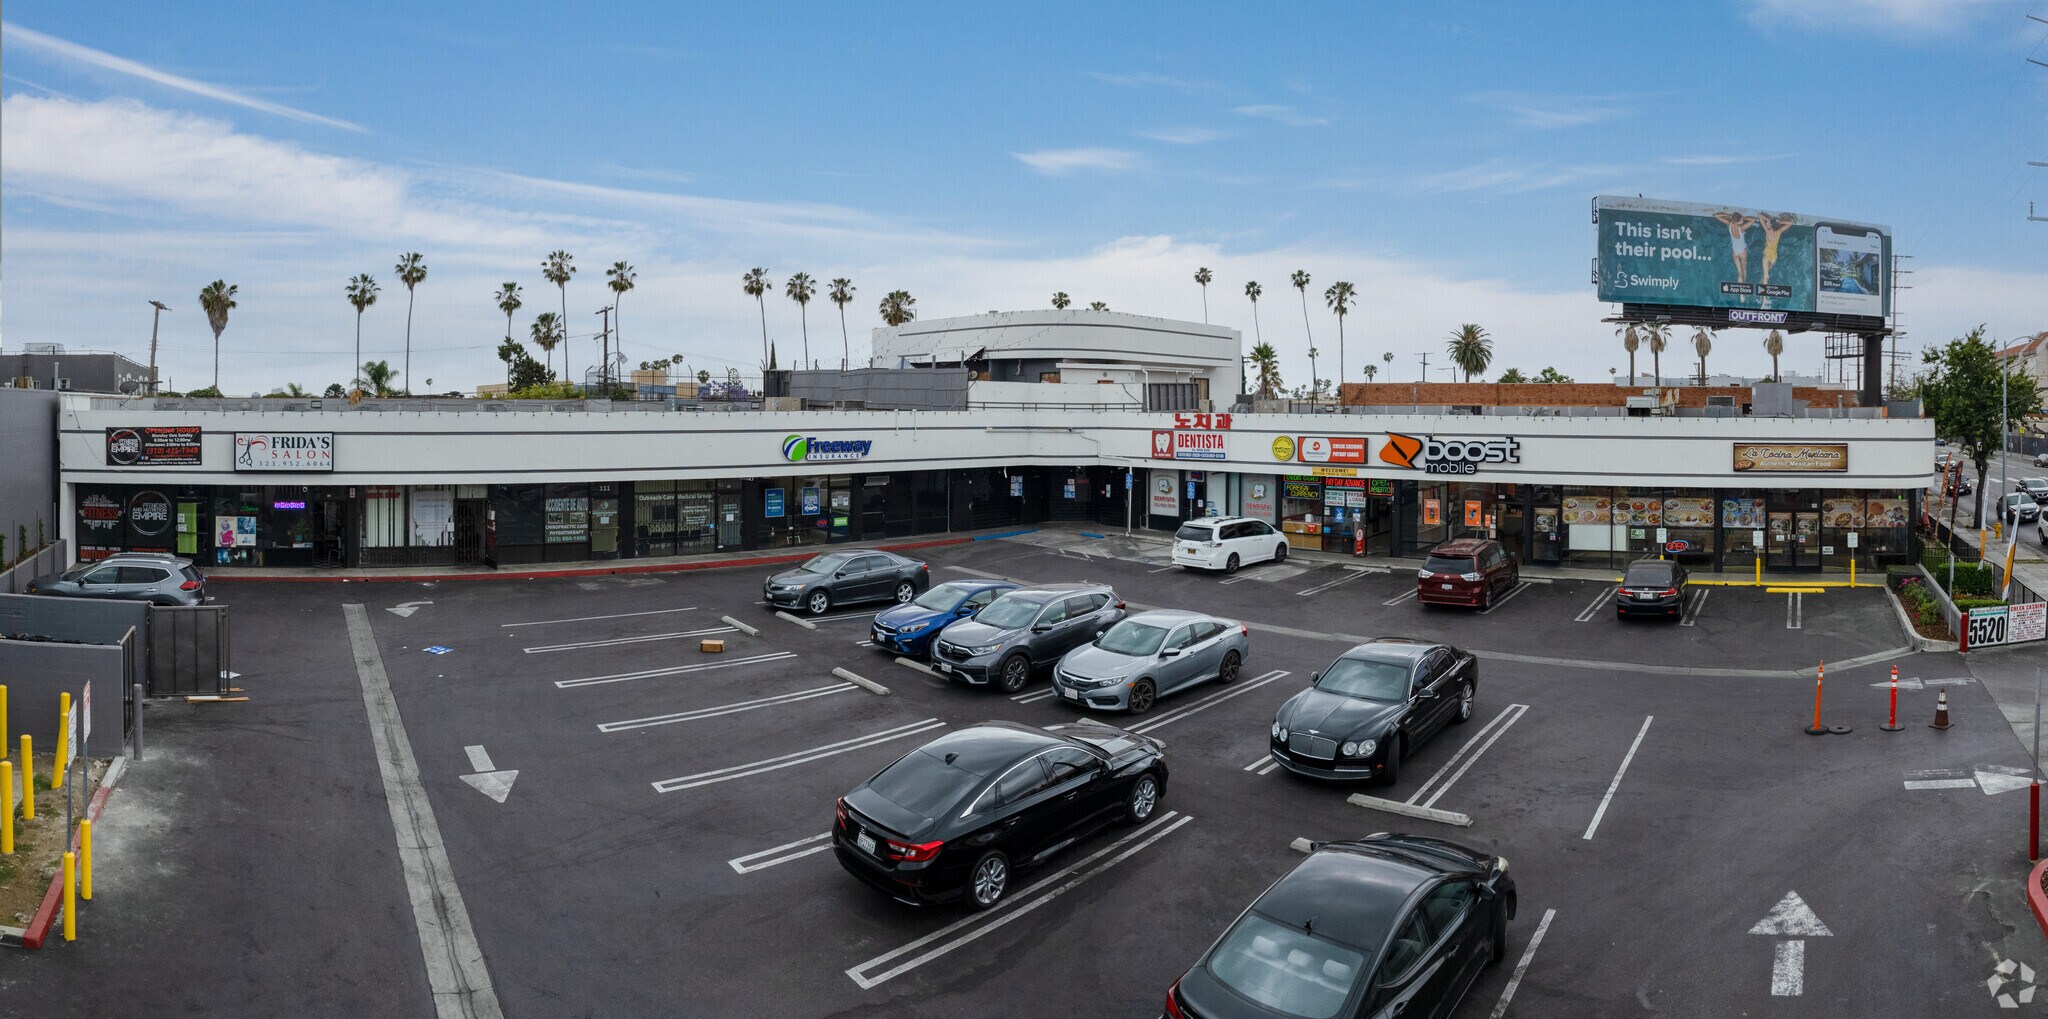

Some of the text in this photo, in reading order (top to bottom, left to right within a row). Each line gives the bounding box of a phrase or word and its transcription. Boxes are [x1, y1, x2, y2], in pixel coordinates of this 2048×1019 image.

[1615, 222, 1652, 238] This
[1615, 242, 1712, 261] their pool...
[1630, 274, 1679, 290] Swimply
[1731, 311, 1784, 321] OUTFRONT
[272, 436, 330, 449] FRIDA'S
[807, 437, 872, 456] Freeway
[1178, 433, 1224, 449] DENTISTA
[271, 450, 330, 459] SALON
[1424, 435, 1520, 463] boost
[1742, 447, 1841, 460] La Cocina Mexicana
[1425, 461, 1476, 474] mobile
[1334, 478, 1344, 486] DAY
[1344, 479, 1365, 488] ADVANCE
[677, 492, 696, 500] Medical
[697, 492, 712, 500] Group
[1291, 490, 1319, 498] CURRENCY
[545, 498, 570, 511] ACCIDENTE
[132, 511, 167, 520] EMPIRE
[1665, 541, 1687, 550] OPEN
[2026, 602, 2046, 610] CASHING
[1968, 616, 2005, 645] 5520
